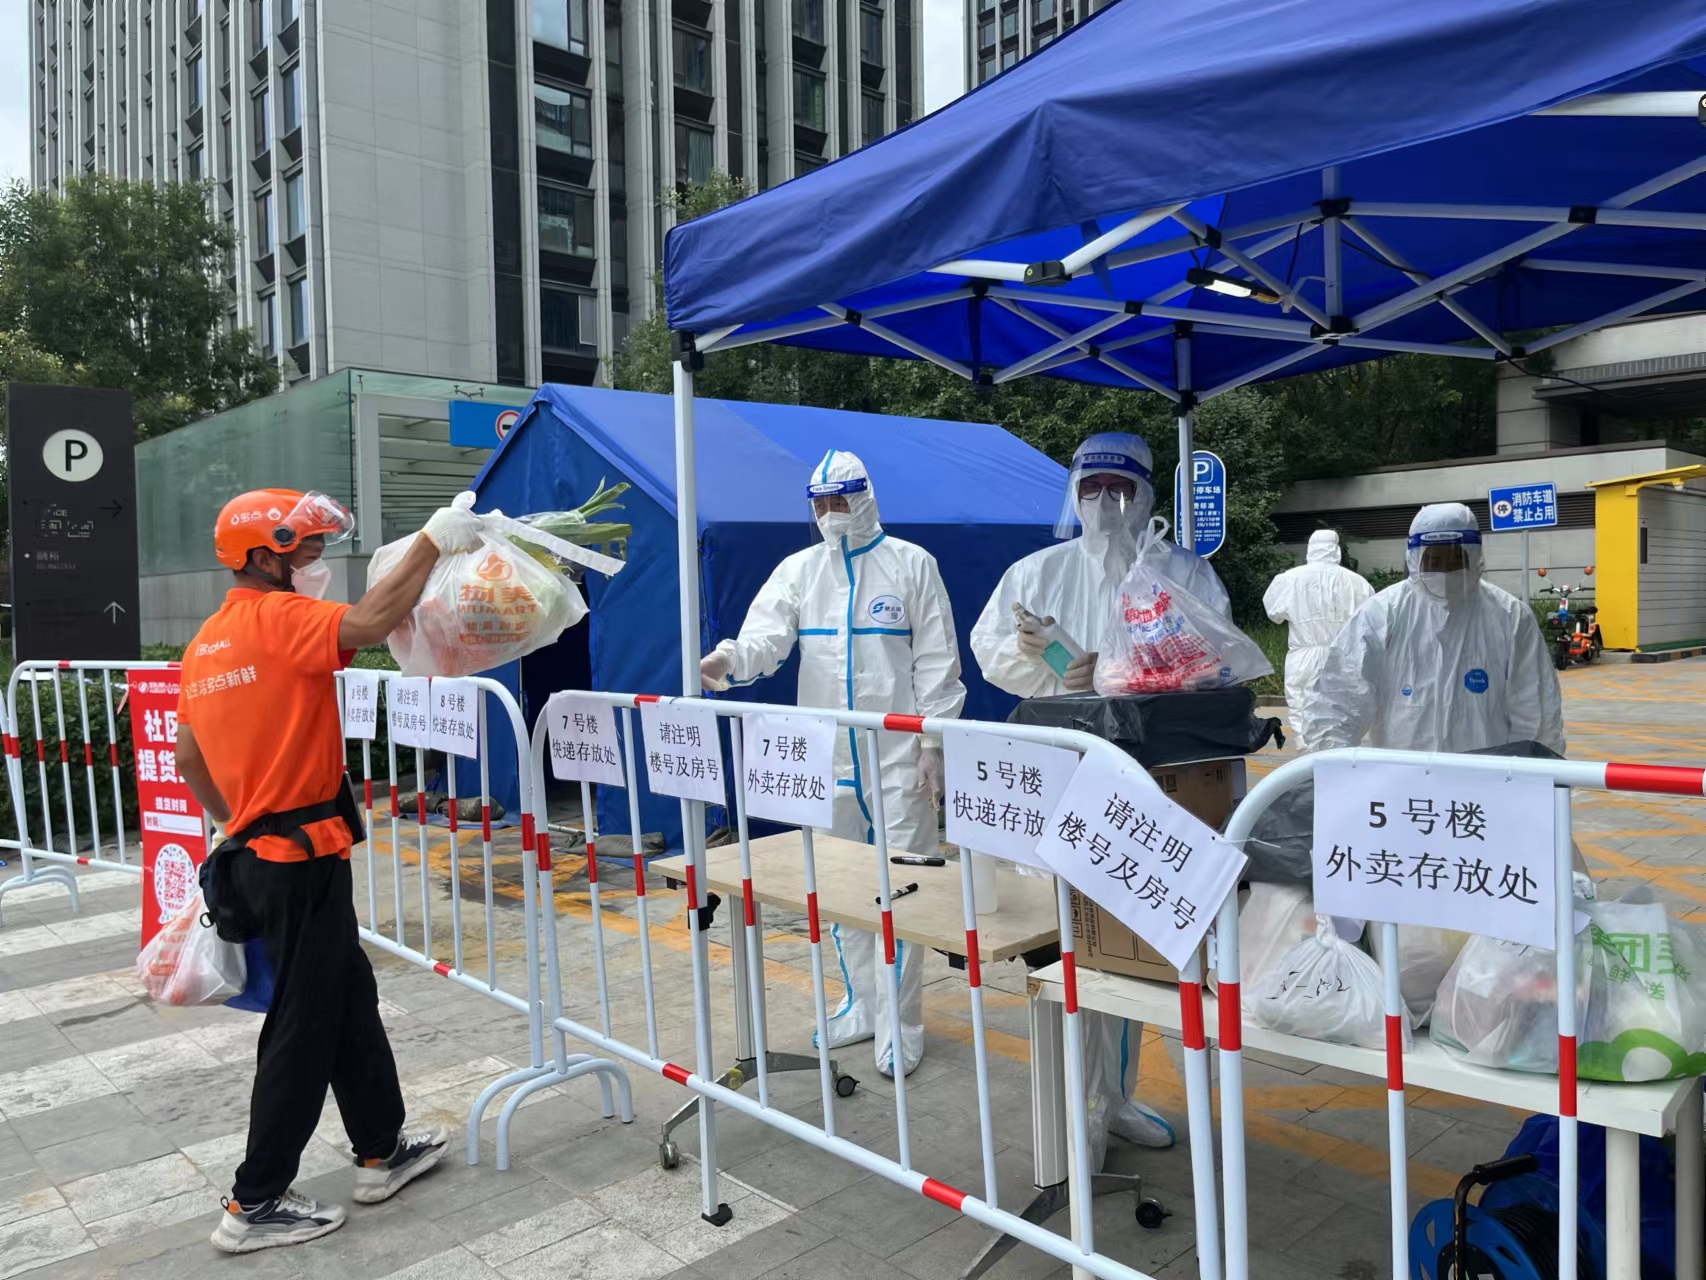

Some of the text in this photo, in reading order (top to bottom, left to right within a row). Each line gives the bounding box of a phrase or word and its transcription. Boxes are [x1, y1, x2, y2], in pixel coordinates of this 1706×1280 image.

[64, 439, 88, 472] P
[1193, 461, 1210, 482] P
[1497, 504, 1508, 515] 停
[1512, 489, 1553, 507] 消防车道
[1513, 505, 1554, 523] 禁止占用
[459, 584, 534, 602] 物美
[397, 688, 419, 707] 请注明
[440, 694, 466, 713] 8号楼
[391, 711, 427, 731] 楼号及房号
[432, 717, 475, 740] 快递存放处
[659, 722, 701, 747] 请注明
[552, 738, 617, 766] 快递存放处
[762, 735, 807, 762] 7号楼
[138, 748, 185, 784] 提货
[649, 751, 719, 781] 楼号及房号
[977, 760, 1042, 797] 5号楼
[748, 769, 826, 801] 外卖存放处
[1102, 792, 1193, 873] 请注明
[1369, 798, 1487, 841] 5号楼
[1058, 811, 1196, 930] 楼号及房号
[1326, 843, 1539, 905] 外卖存放处
